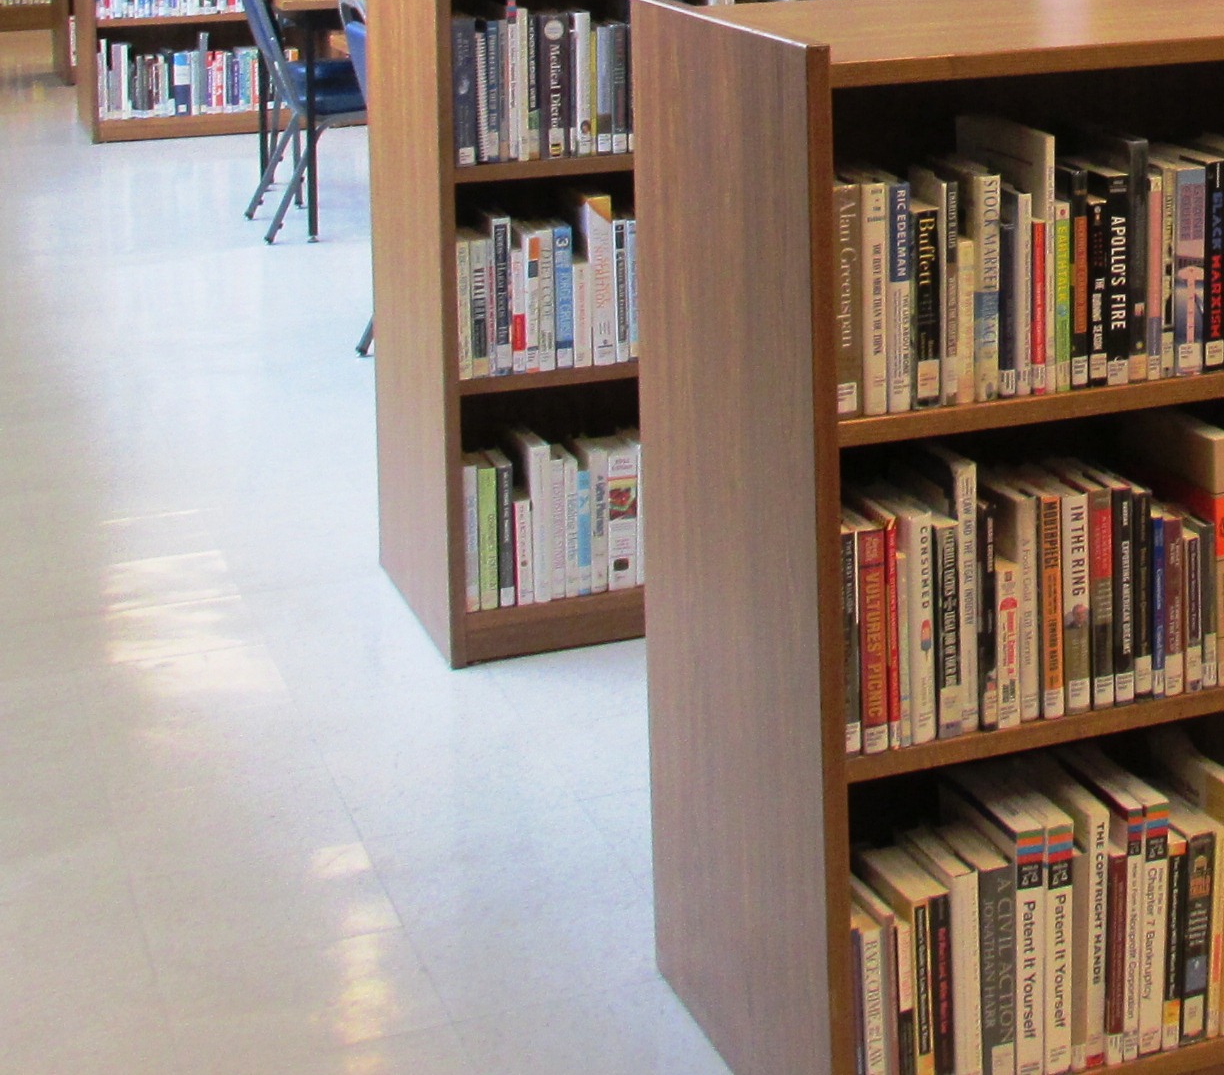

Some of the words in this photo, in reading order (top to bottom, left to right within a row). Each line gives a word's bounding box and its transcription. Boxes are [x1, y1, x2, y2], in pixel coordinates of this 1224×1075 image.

[550, 44, 561, 89] Medical
[550, 94, 561, 130] Dictio
[839, 200, 857, 243] Alan
[896, 190, 906, 210] RIC
[983, 180, 998, 226] STOCK
[1210, 192, 1223, 250] BLACK
[896, 214, 907, 277] EDELMAN
[918, 217, 936, 286] Buffett
[948, 230, 957, 249] ELLIS
[1111, 216, 1126, 286] APOLLO'S
[982, 233, 998, 291] MARKET
[1057, 226, 1068, 302] EARTHTALK
[1094, 277, 1105, 291] THE
[836, 246, 857, 349] Greenspan
[1111, 294, 1126, 330] FIRE
[1210, 255, 1222, 338] MARXISM
[1092, 324, 1103, 351] SEASON
[964, 497, 974, 515] LAW
[964, 519, 974, 536] AND
[1070, 506, 1085, 522] IN
[964, 540, 974, 554] THE
[1044, 501, 1060, 570] MOUTHPIECE
[1070, 525, 1085, 554] THE
[919, 526, 930, 609] CONSUMED
[964, 559, 974, 584] LEGAL
[1070, 559, 1085, 597] RING
[1121, 541, 1131, 582] EXPORTING
[846, 583, 854, 614] BILLION
[865, 571, 882, 657] VULTURES'
[964, 588, 974, 626] INDUSTRY
[1023, 610, 1033, 628] Bill
[1121, 583, 1131, 622] AMERICAN
[1121, 623, 1131, 655] DREAMS
[867, 663, 883, 718] PICNIC
[1096, 822, 1105, 849] THE
[997, 878, 1010, 892] A
[1094, 853, 1104, 930] COPYRIGHT
[1145, 868, 1158, 916] Chapter
[982, 900, 996, 982] JONATHAN
[997, 897, 1013, 957] CIVIL
[1023, 901, 1037, 954] Patent
[1054, 894, 1067, 946] Patent
[1129, 915, 1138, 959] Nonprofit
[1023, 957, 1037, 969] It
[1054, 949, 1067, 960] It
[1092, 934, 1102, 985] HANDB
[1141, 930, 1156, 1000] Bankruptcy
[984, 987, 996, 1030] HARR
[998, 962, 1014, 1043] ACTION
[1023, 972, 1037, 1040] Yourself
[1054, 965, 1067, 1028] Yourself
[1126, 961, 1138, 1019] Corporation
